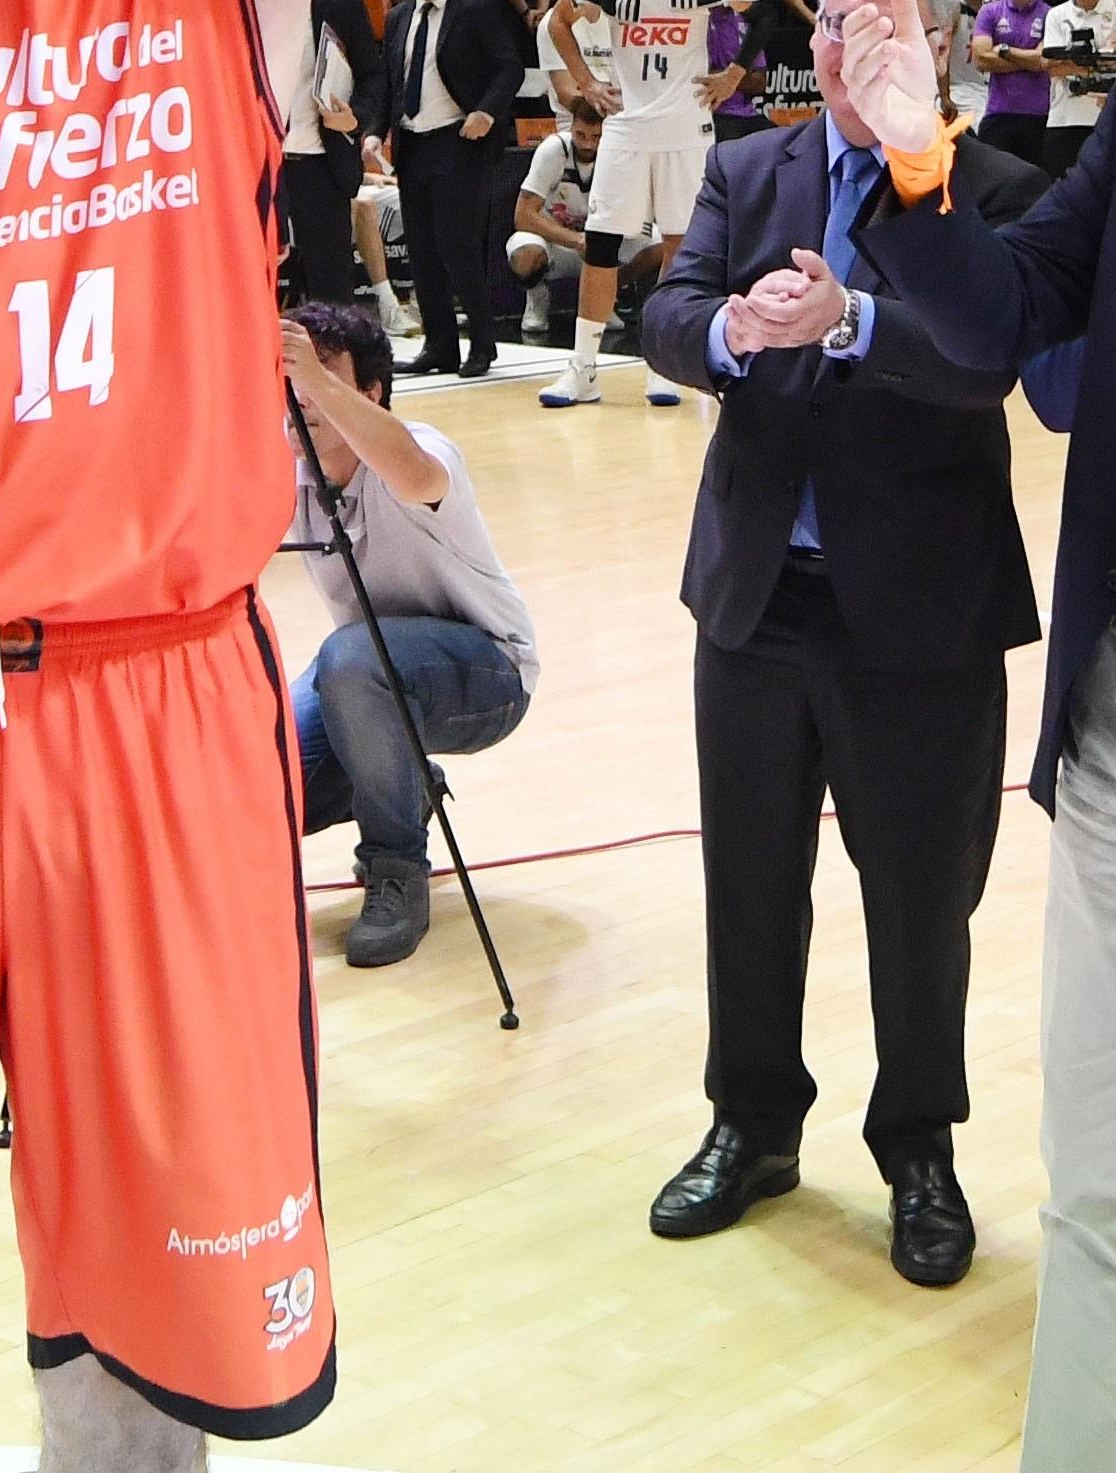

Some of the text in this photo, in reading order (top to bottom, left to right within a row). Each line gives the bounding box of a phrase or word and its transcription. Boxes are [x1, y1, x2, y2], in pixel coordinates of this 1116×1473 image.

[641, 53, 668, 81] 14
[765, 62, 819, 95] ultura
[6, 266, 116, 424] 14
[166, 1218, 280, 1261] Atmósfera
